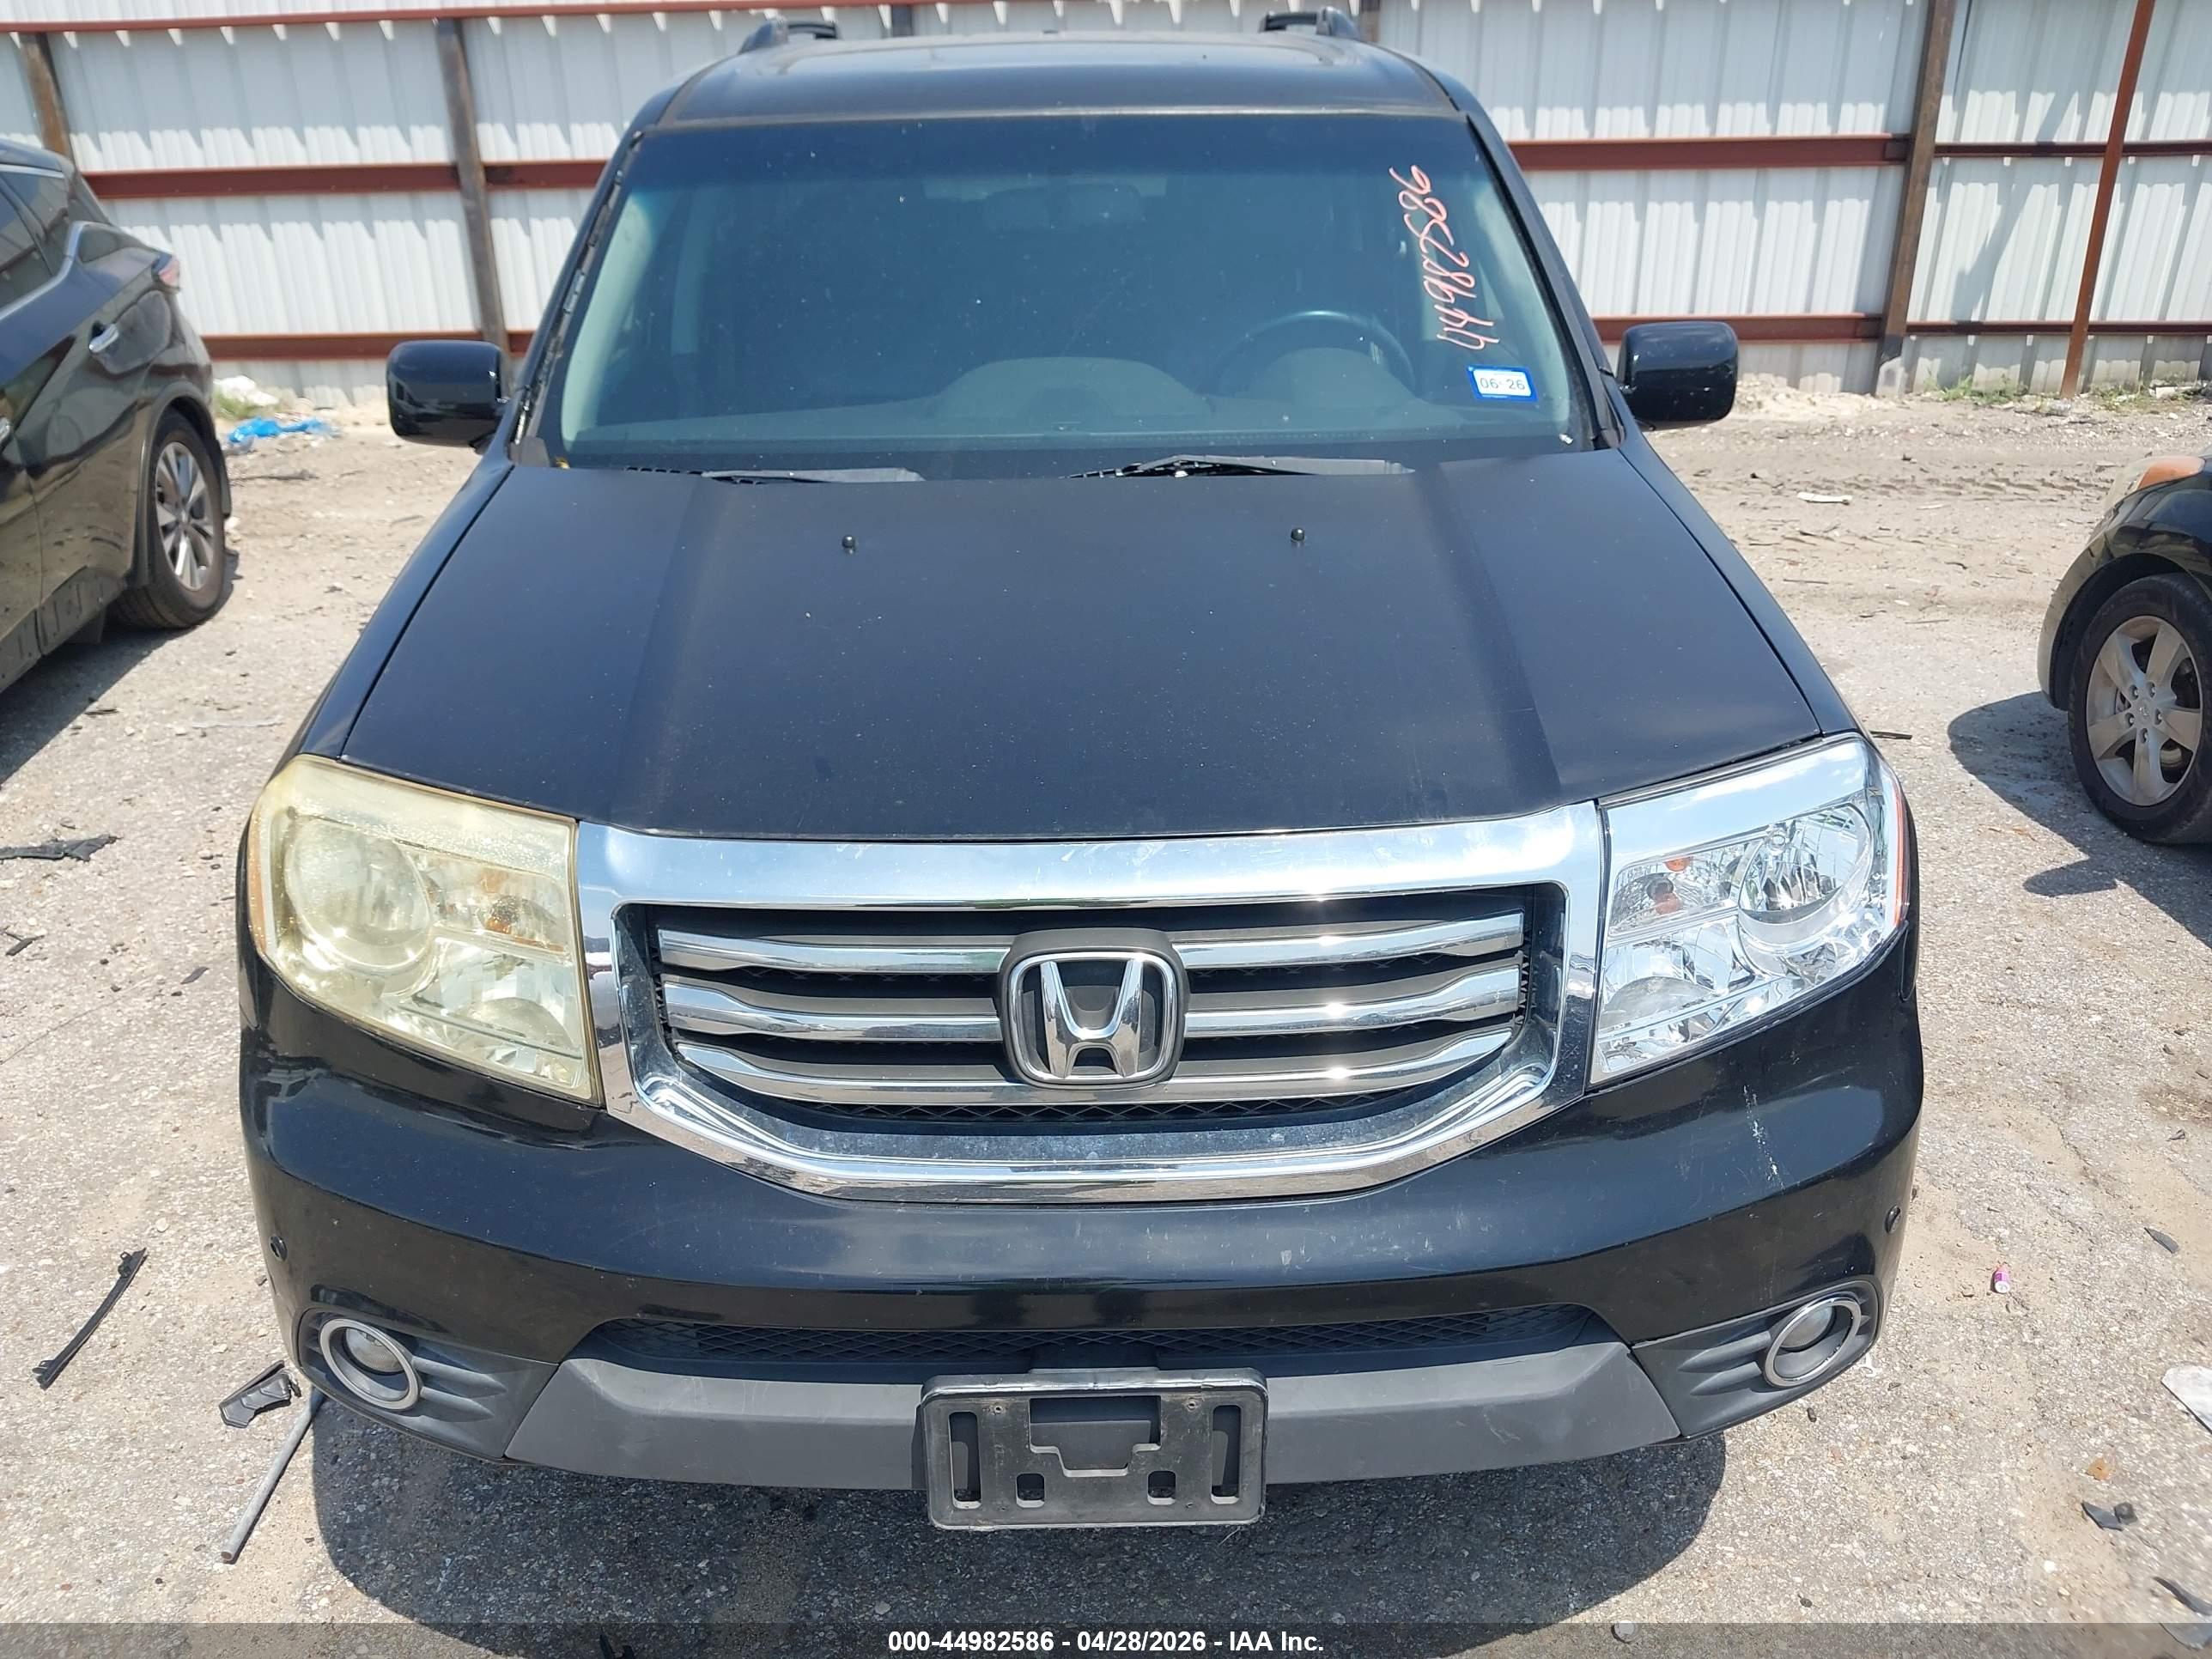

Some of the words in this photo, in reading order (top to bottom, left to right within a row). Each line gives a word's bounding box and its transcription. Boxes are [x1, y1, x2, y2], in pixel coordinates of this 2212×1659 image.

[1388, 164, 1500, 350] 44982586
[1480, 377, 1498, 389] 06
[1506, 378, 1525, 391] 26
